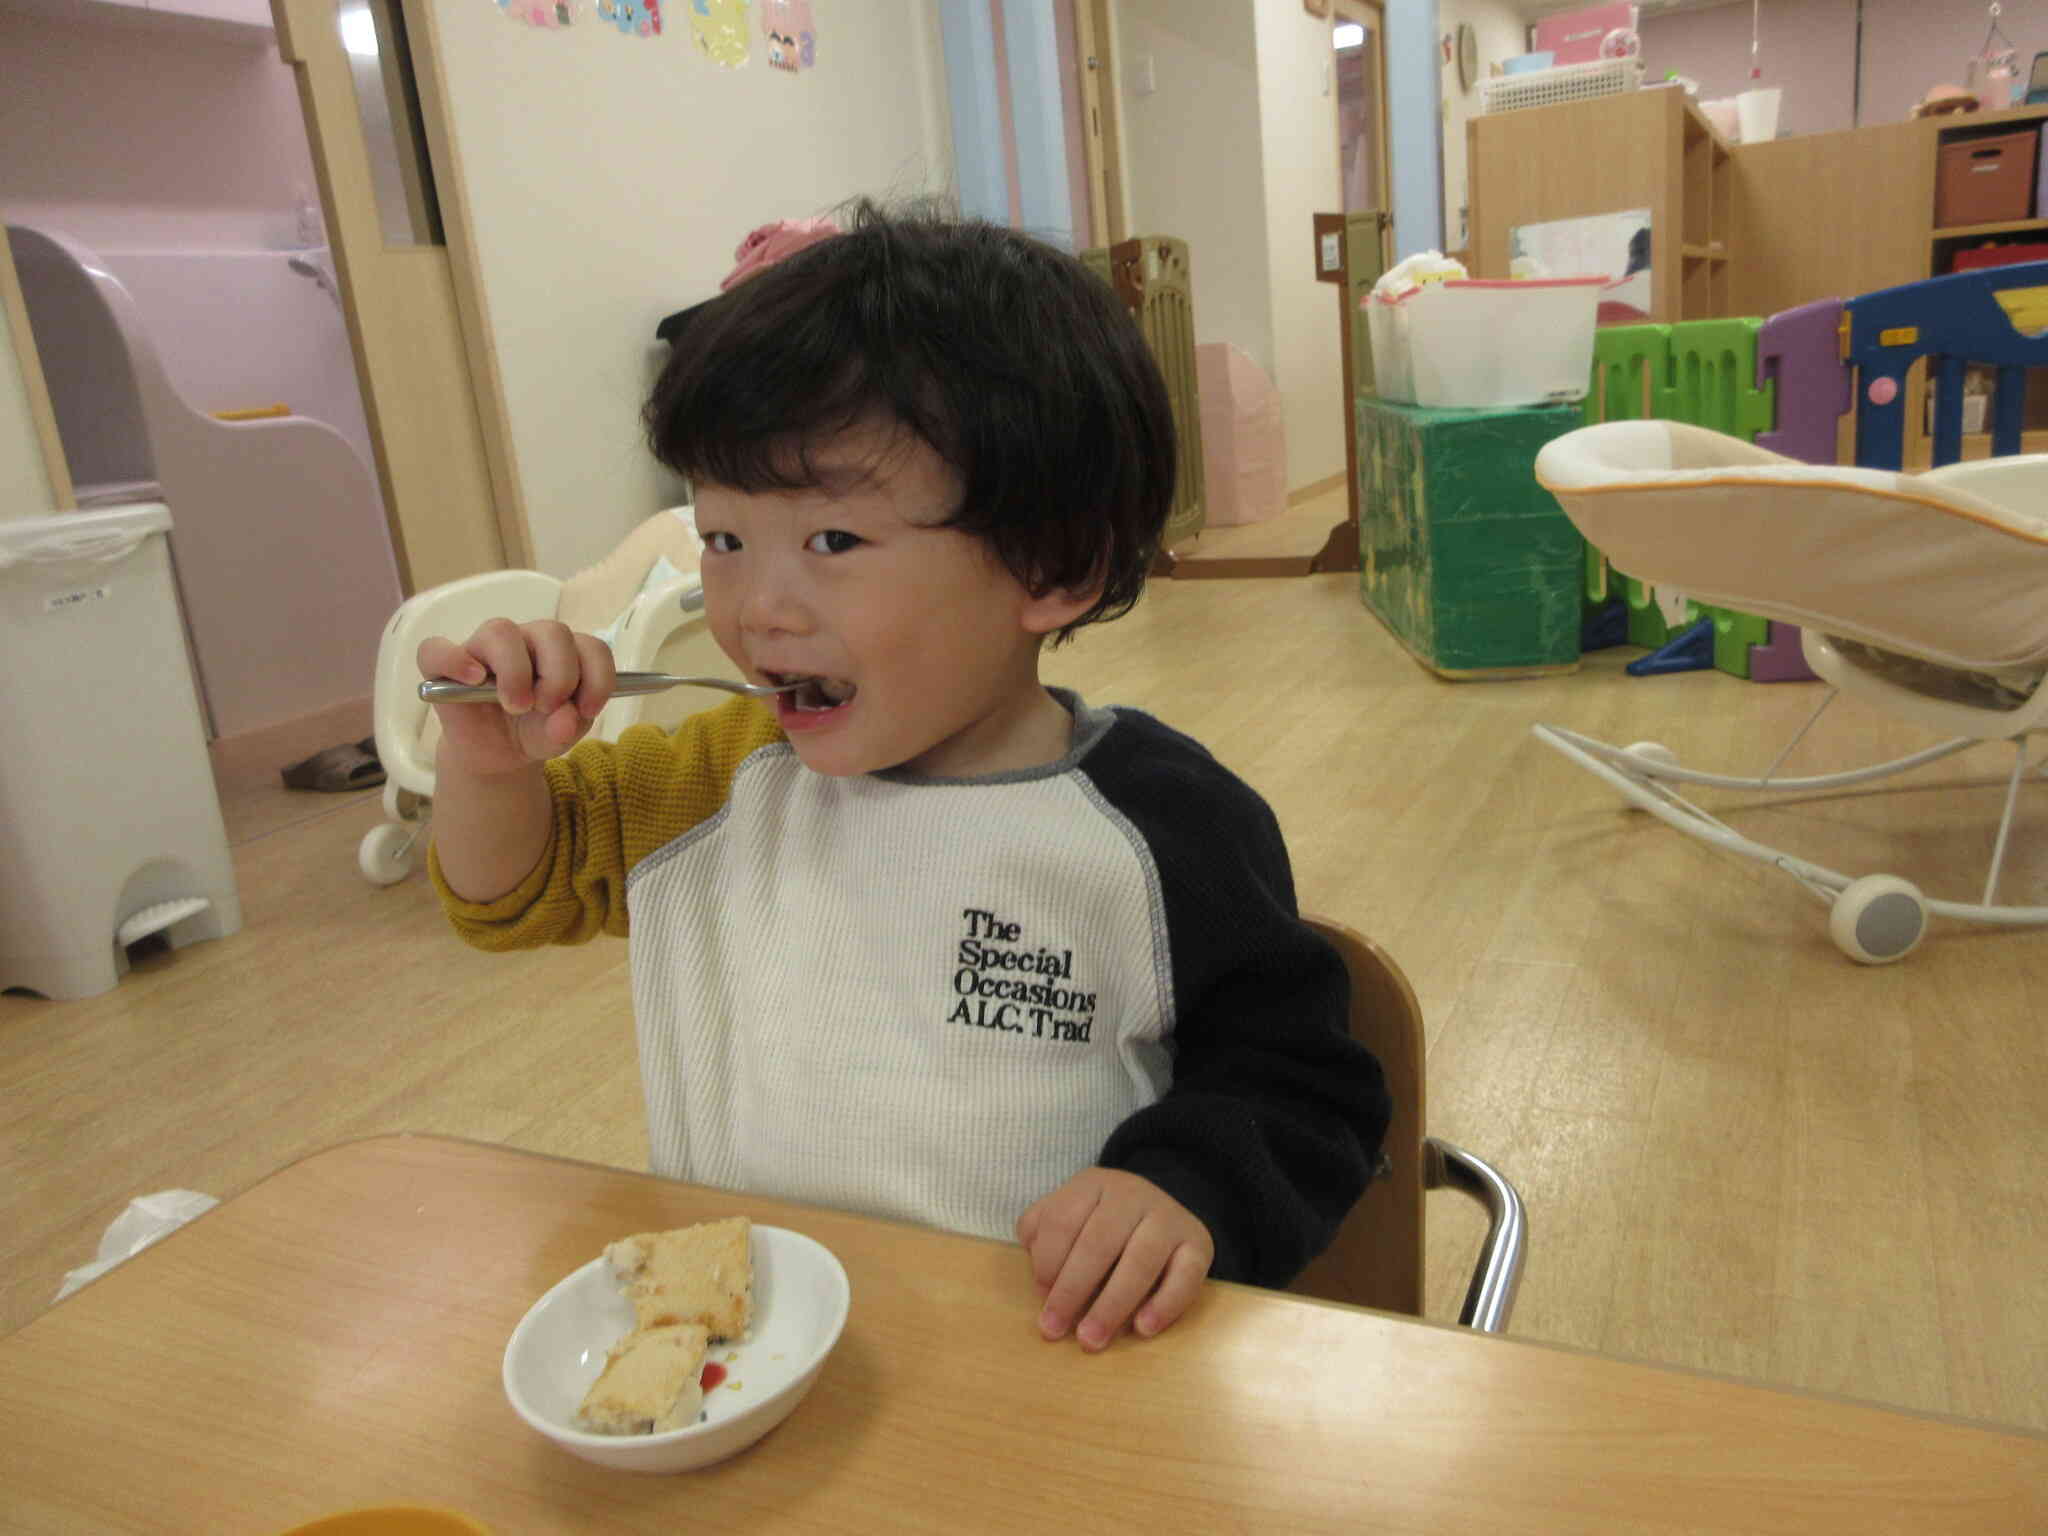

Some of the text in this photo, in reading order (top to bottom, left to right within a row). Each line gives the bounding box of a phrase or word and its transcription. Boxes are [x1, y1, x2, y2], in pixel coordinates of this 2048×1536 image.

[963, 908, 1021, 942] The
[958, 940, 1072, 979] Special
[954, 968, 1096, 1013] Occasions
[1030, 1008, 1093, 1043] Trad
